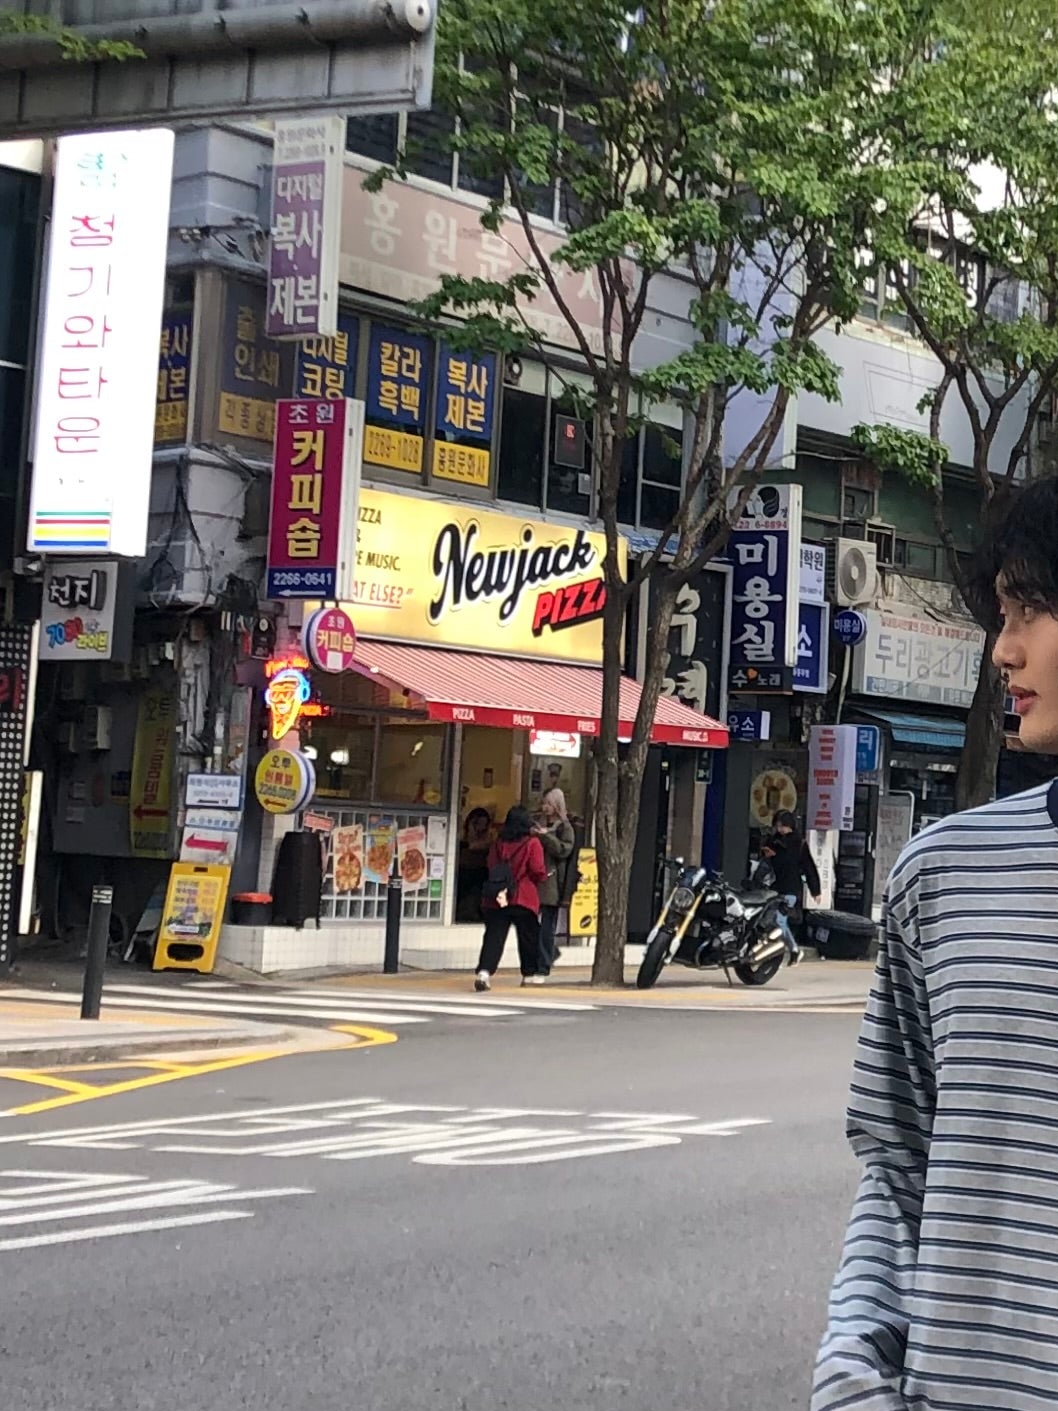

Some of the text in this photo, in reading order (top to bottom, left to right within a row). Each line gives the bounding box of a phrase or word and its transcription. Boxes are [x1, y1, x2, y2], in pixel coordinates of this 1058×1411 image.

[277, 173, 322, 203] 디지털
[272, 210, 322, 261] 복사
[270, 275, 319, 326] 제본
[302, 361, 345, 400] 코팅
[380, 341, 422, 383] 칼라
[447, 357, 488, 399] 복사
[378, 380, 421, 421] 흑백
[445, 394, 487, 433] 제본
[286, 429, 326, 560] 커피숍
[273, 572, 332, 586] 2266-0641
[800, 548, 824, 571] 학원
[732, 534, 784, 662] 미용실
[317, 630, 354, 653] 커피숍
[834, 618, 861, 633] 미용실
[452, 707, 475, 721] PIZZA
[512, 714, 535, 727] PASTA
